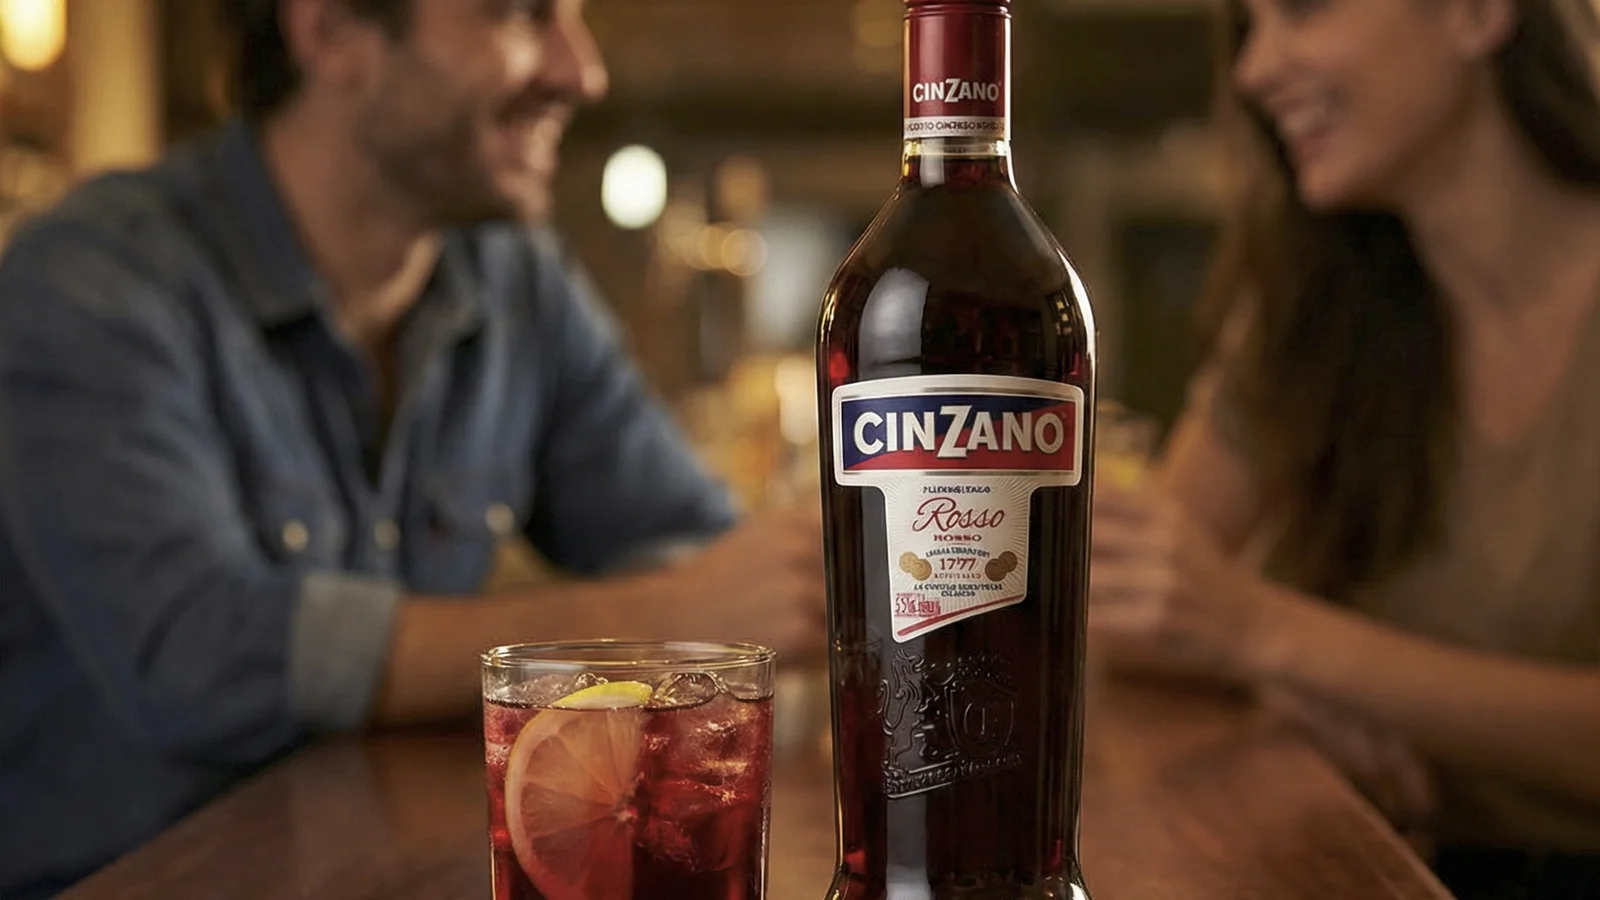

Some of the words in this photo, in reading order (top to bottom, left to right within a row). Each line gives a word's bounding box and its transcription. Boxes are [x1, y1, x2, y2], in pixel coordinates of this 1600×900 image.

[913, 78, 999, 102] CINZANO
[854, 405, 1064, 457] CINZANO
[912, 497, 1005, 532] Rosso
